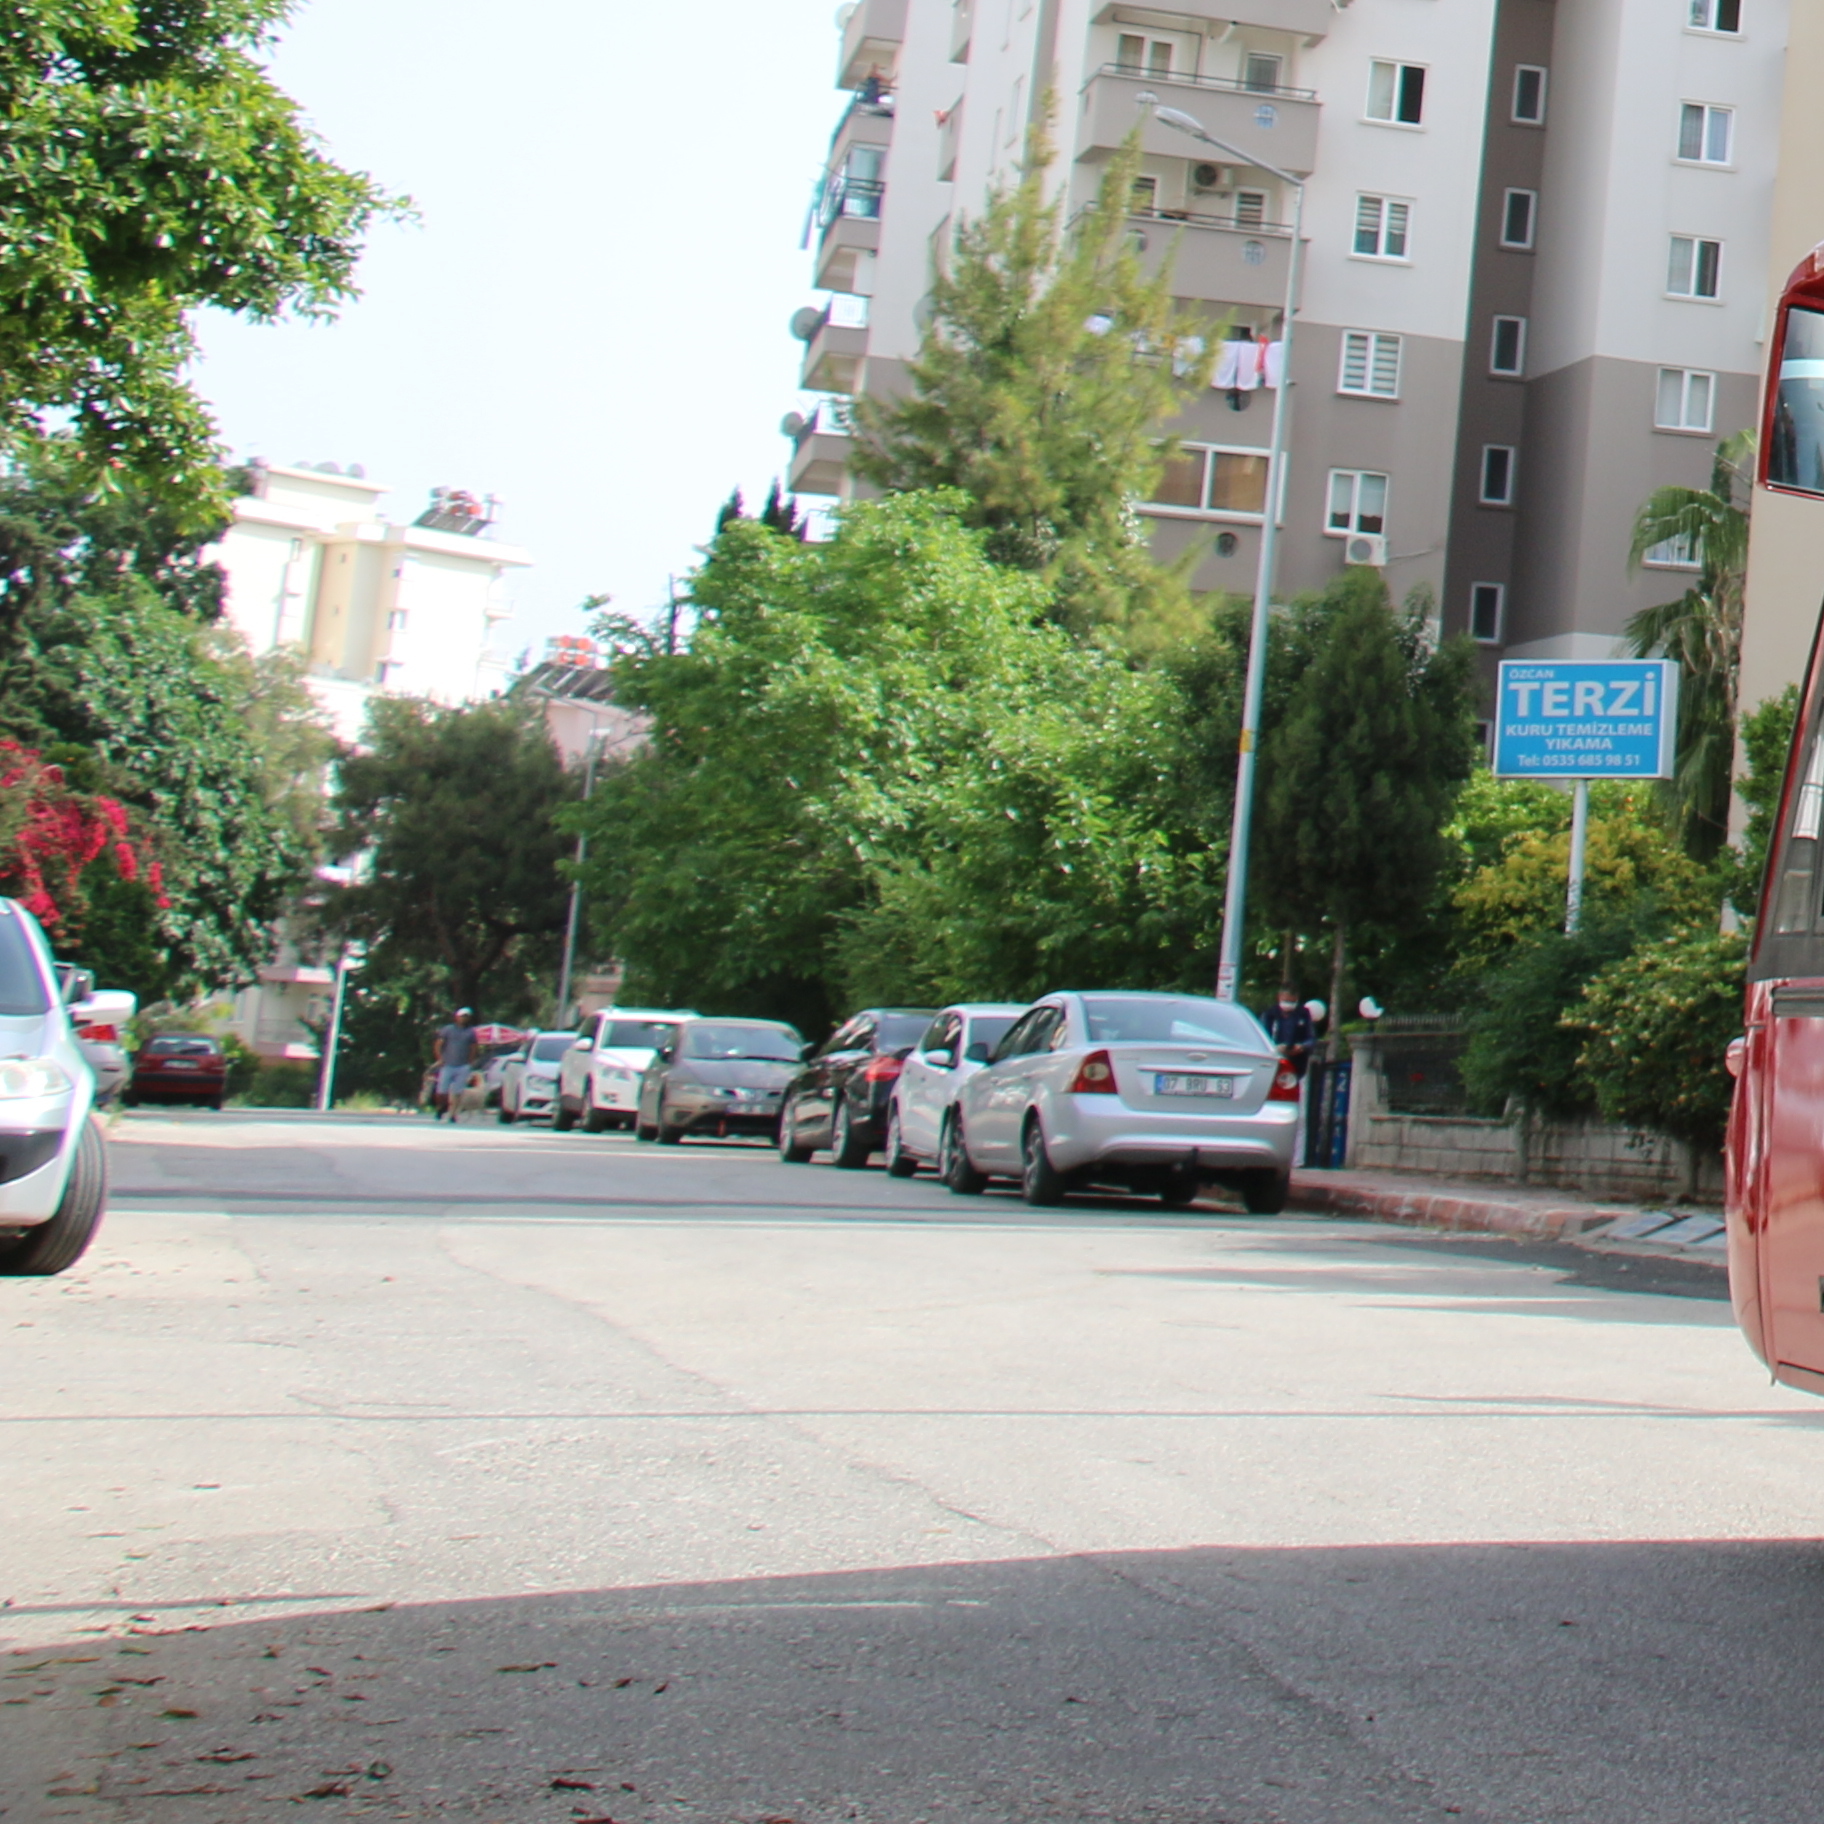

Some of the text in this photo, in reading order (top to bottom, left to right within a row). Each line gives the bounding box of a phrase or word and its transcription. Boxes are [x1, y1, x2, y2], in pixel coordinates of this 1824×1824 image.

[1508, 672, 1655, 716] TERZİ
[1506, 721, 1652, 737] KURU TEMİZLEME
[1546, 738, 1612, 750] YIKAMA
[1517, 755, 1540, 766] Tel:
[1542, 755, 1575, 766] 0535
